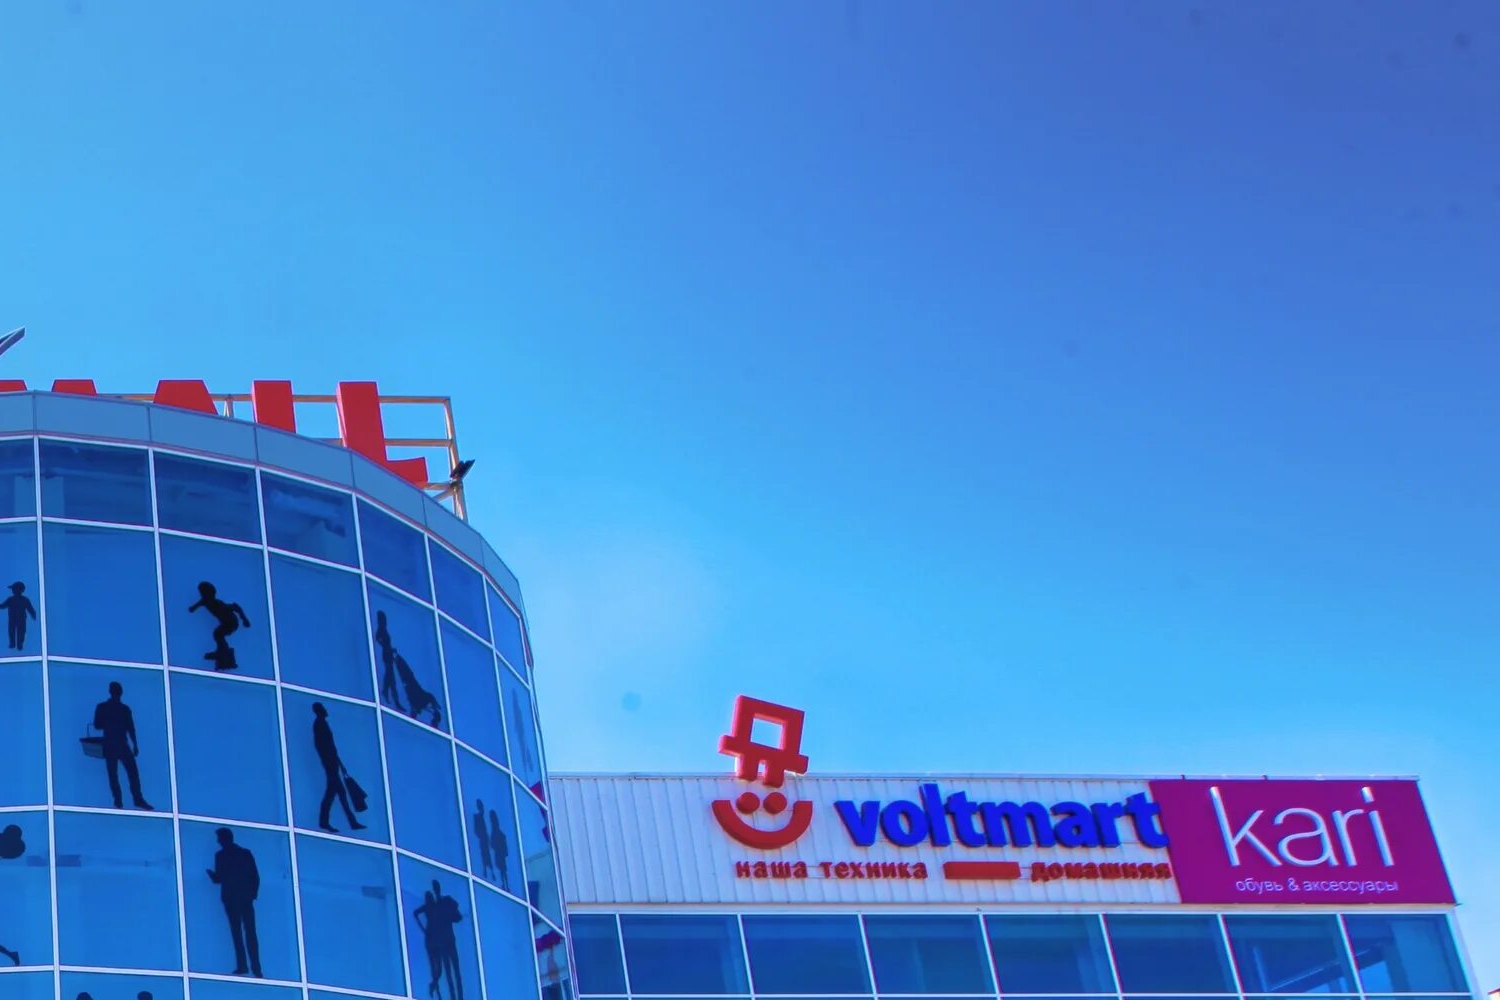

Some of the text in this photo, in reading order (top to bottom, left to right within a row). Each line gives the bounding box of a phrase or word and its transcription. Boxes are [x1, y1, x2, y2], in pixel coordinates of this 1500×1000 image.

[834, 783, 1169, 848] voltmart
[1209, 786, 1394, 867] kari
[735, 860, 1174, 883] наша техника домашняя
[1236, 878, 1400, 895] обувь & аксессуары
